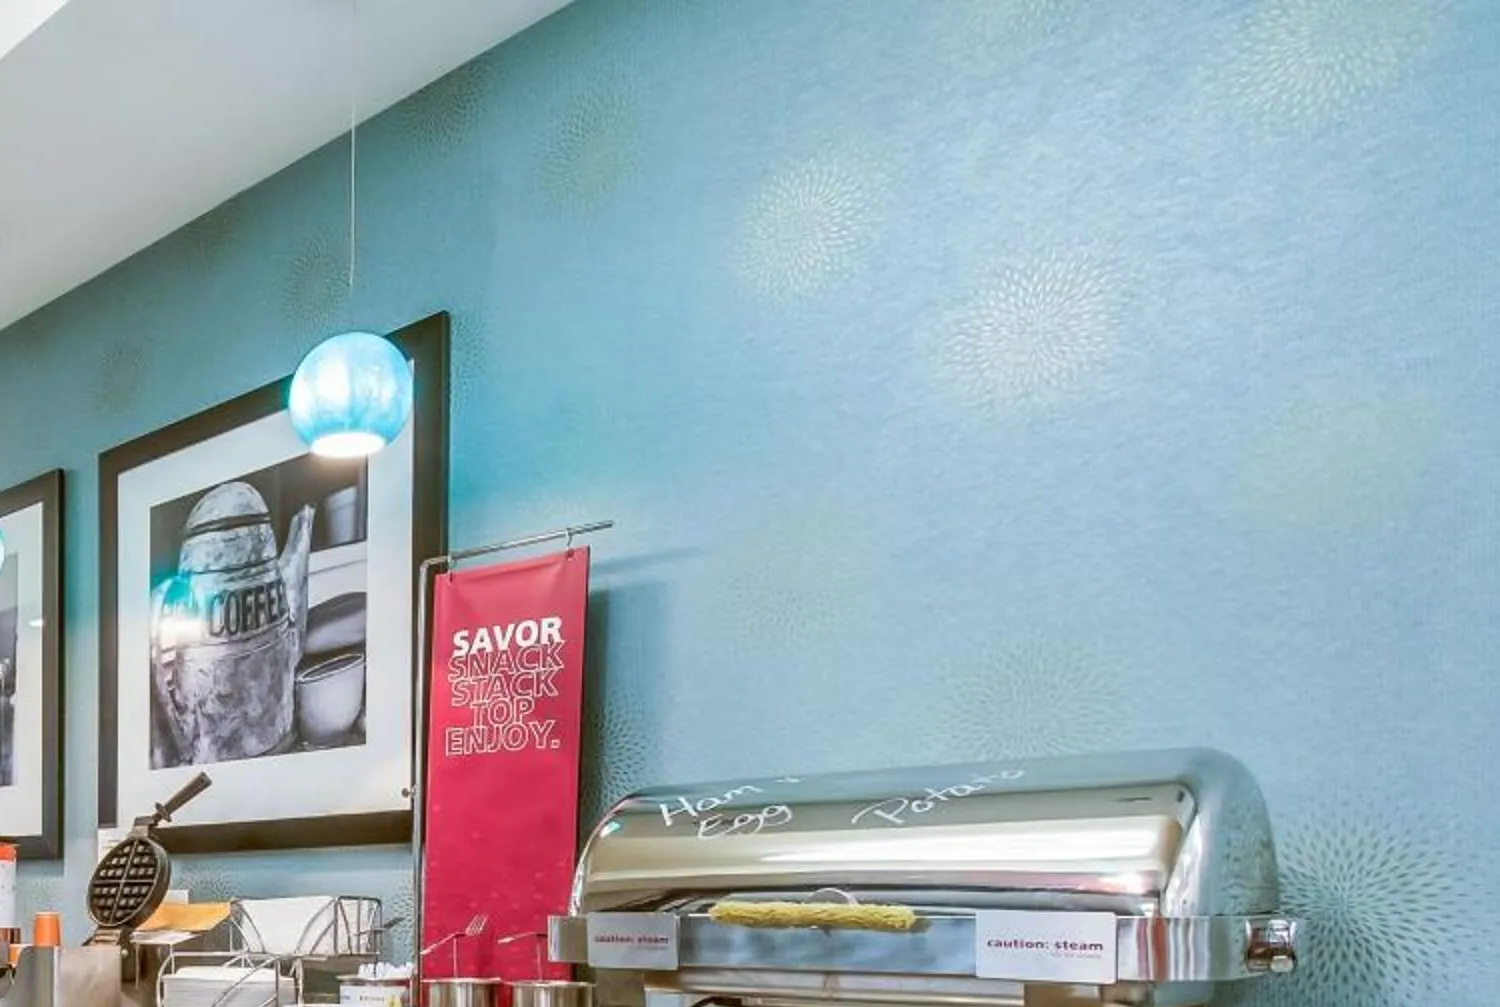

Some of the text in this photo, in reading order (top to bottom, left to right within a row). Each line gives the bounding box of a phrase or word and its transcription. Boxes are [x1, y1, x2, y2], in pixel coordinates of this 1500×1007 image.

[452, 616, 562, 658] SAVOR
[448, 640, 564, 682] SNACK
[451, 668, 559, 707] STACK
[470, 696, 534, 727] TOP
[446, 719, 560, 756] ENJOY.
[659, 785, 763, 827] Ham
[851, 769, 1025, 825] Potato
[698, 804, 793, 840] Egg
[987, 938, 1104, 951] caution: steam
